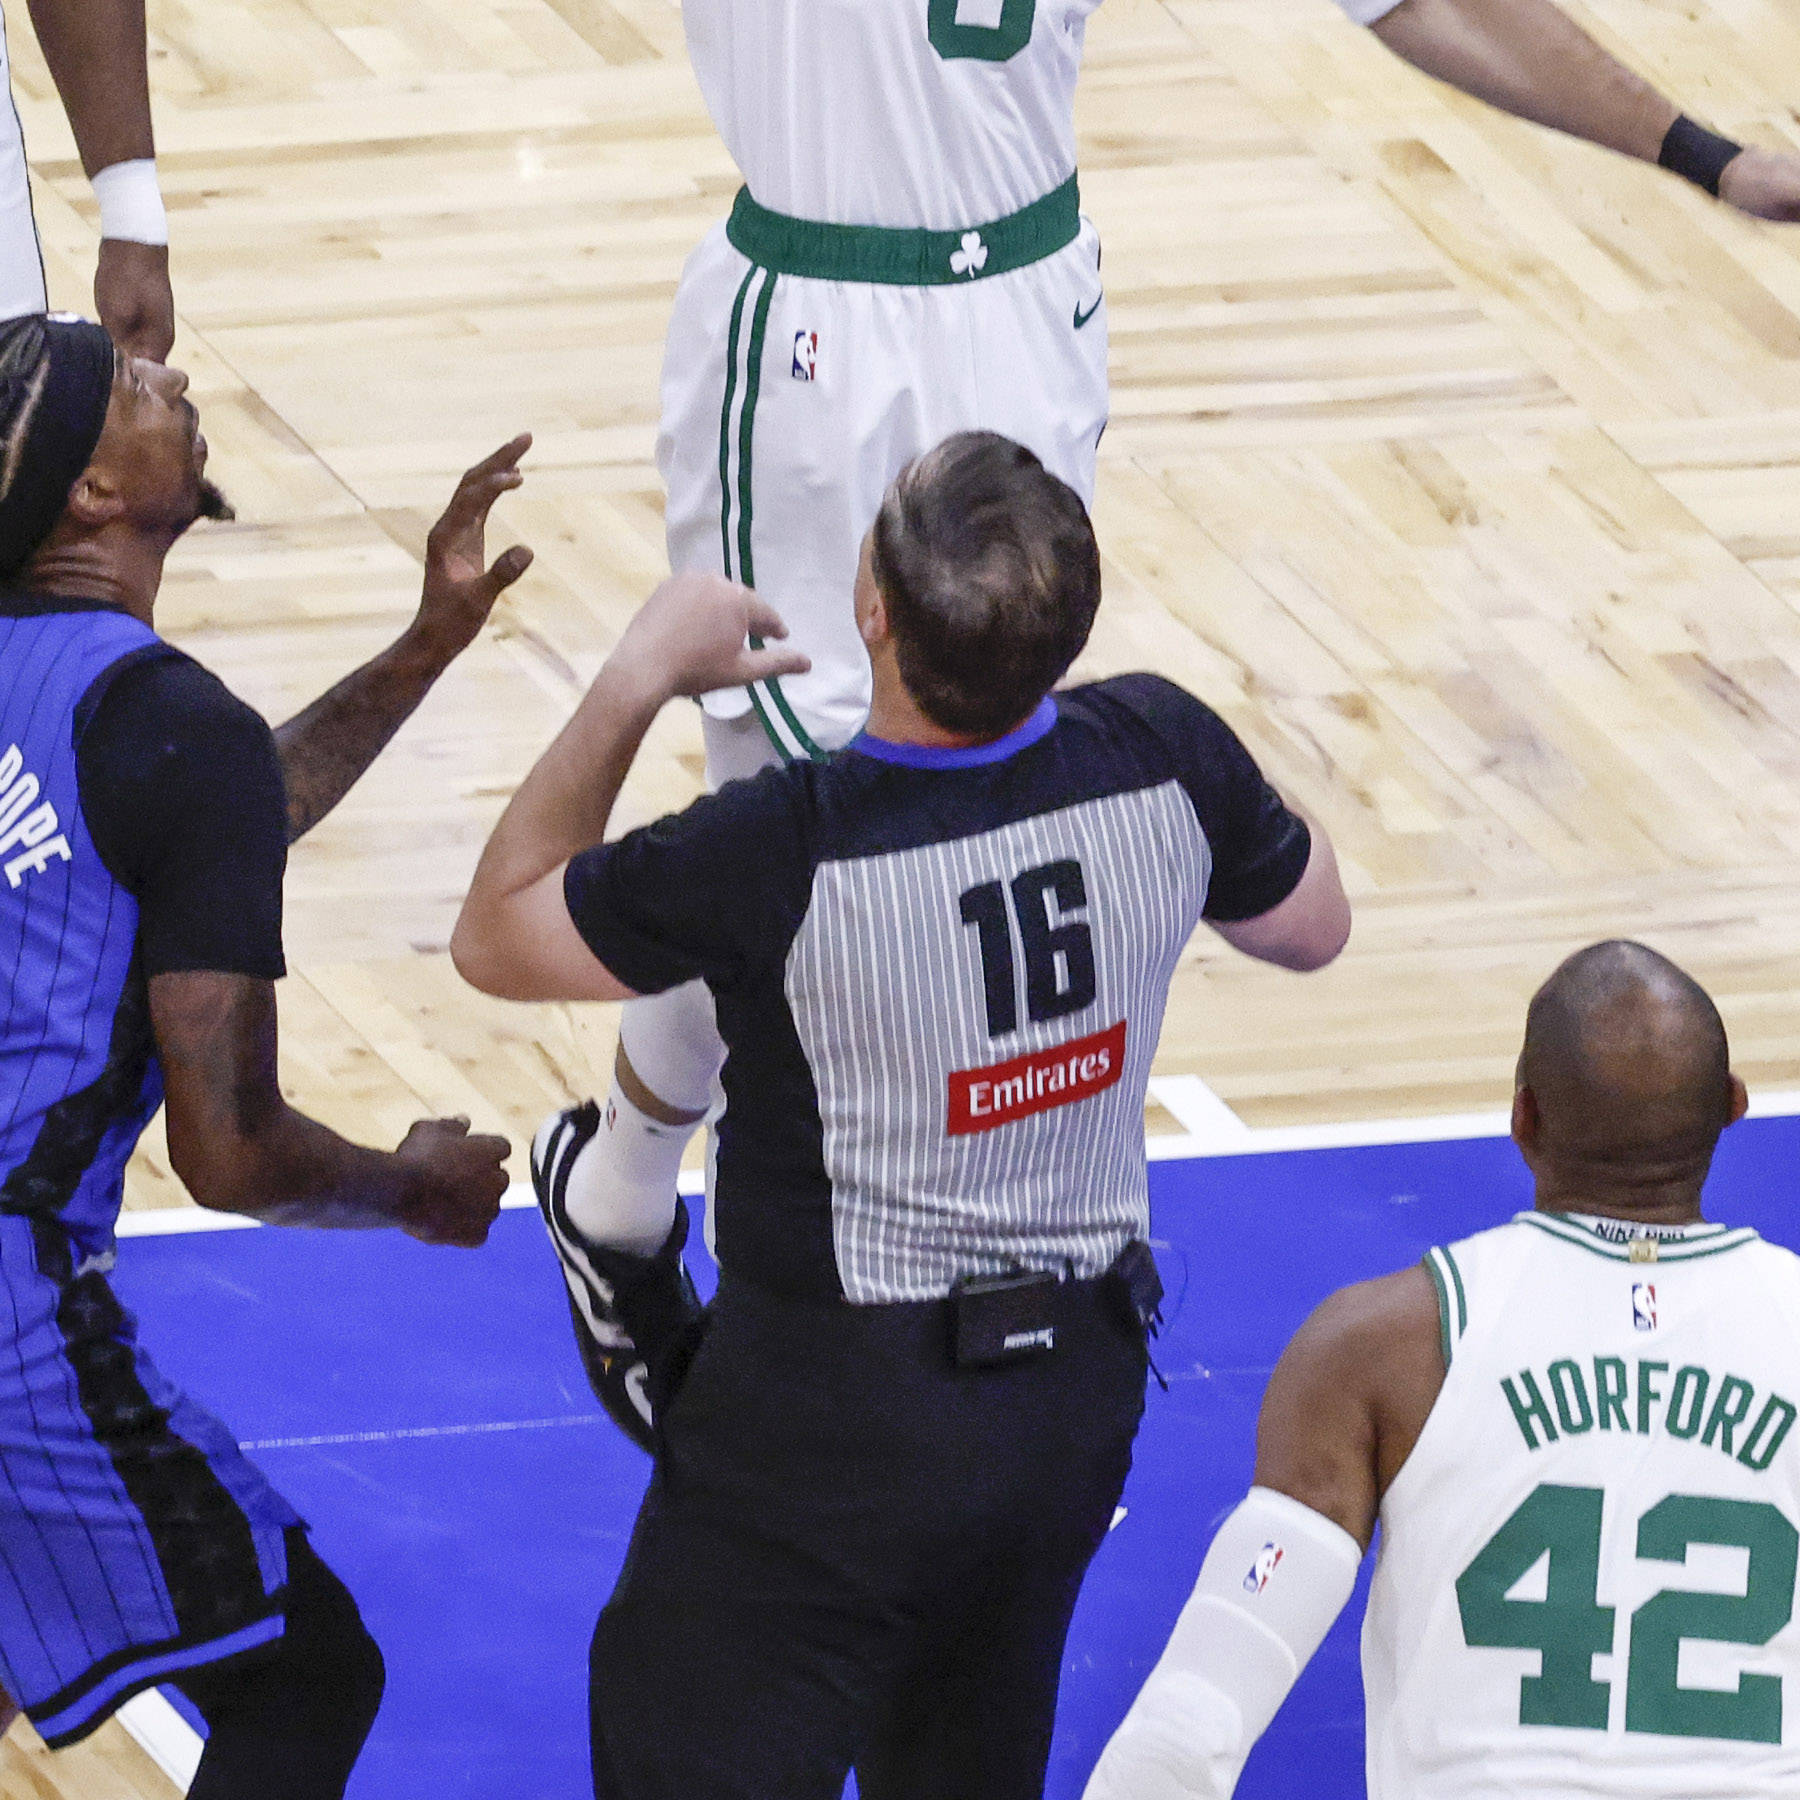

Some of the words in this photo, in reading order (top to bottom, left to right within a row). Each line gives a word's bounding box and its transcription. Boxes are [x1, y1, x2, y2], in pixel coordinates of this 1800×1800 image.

[959, 859, 1097, 1038] 16
[969, 1047, 1111, 1118] Emirates
[1500, 1355, 1798, 1472] HORFORD
[1455, 1482, 1800, 1745] 42
